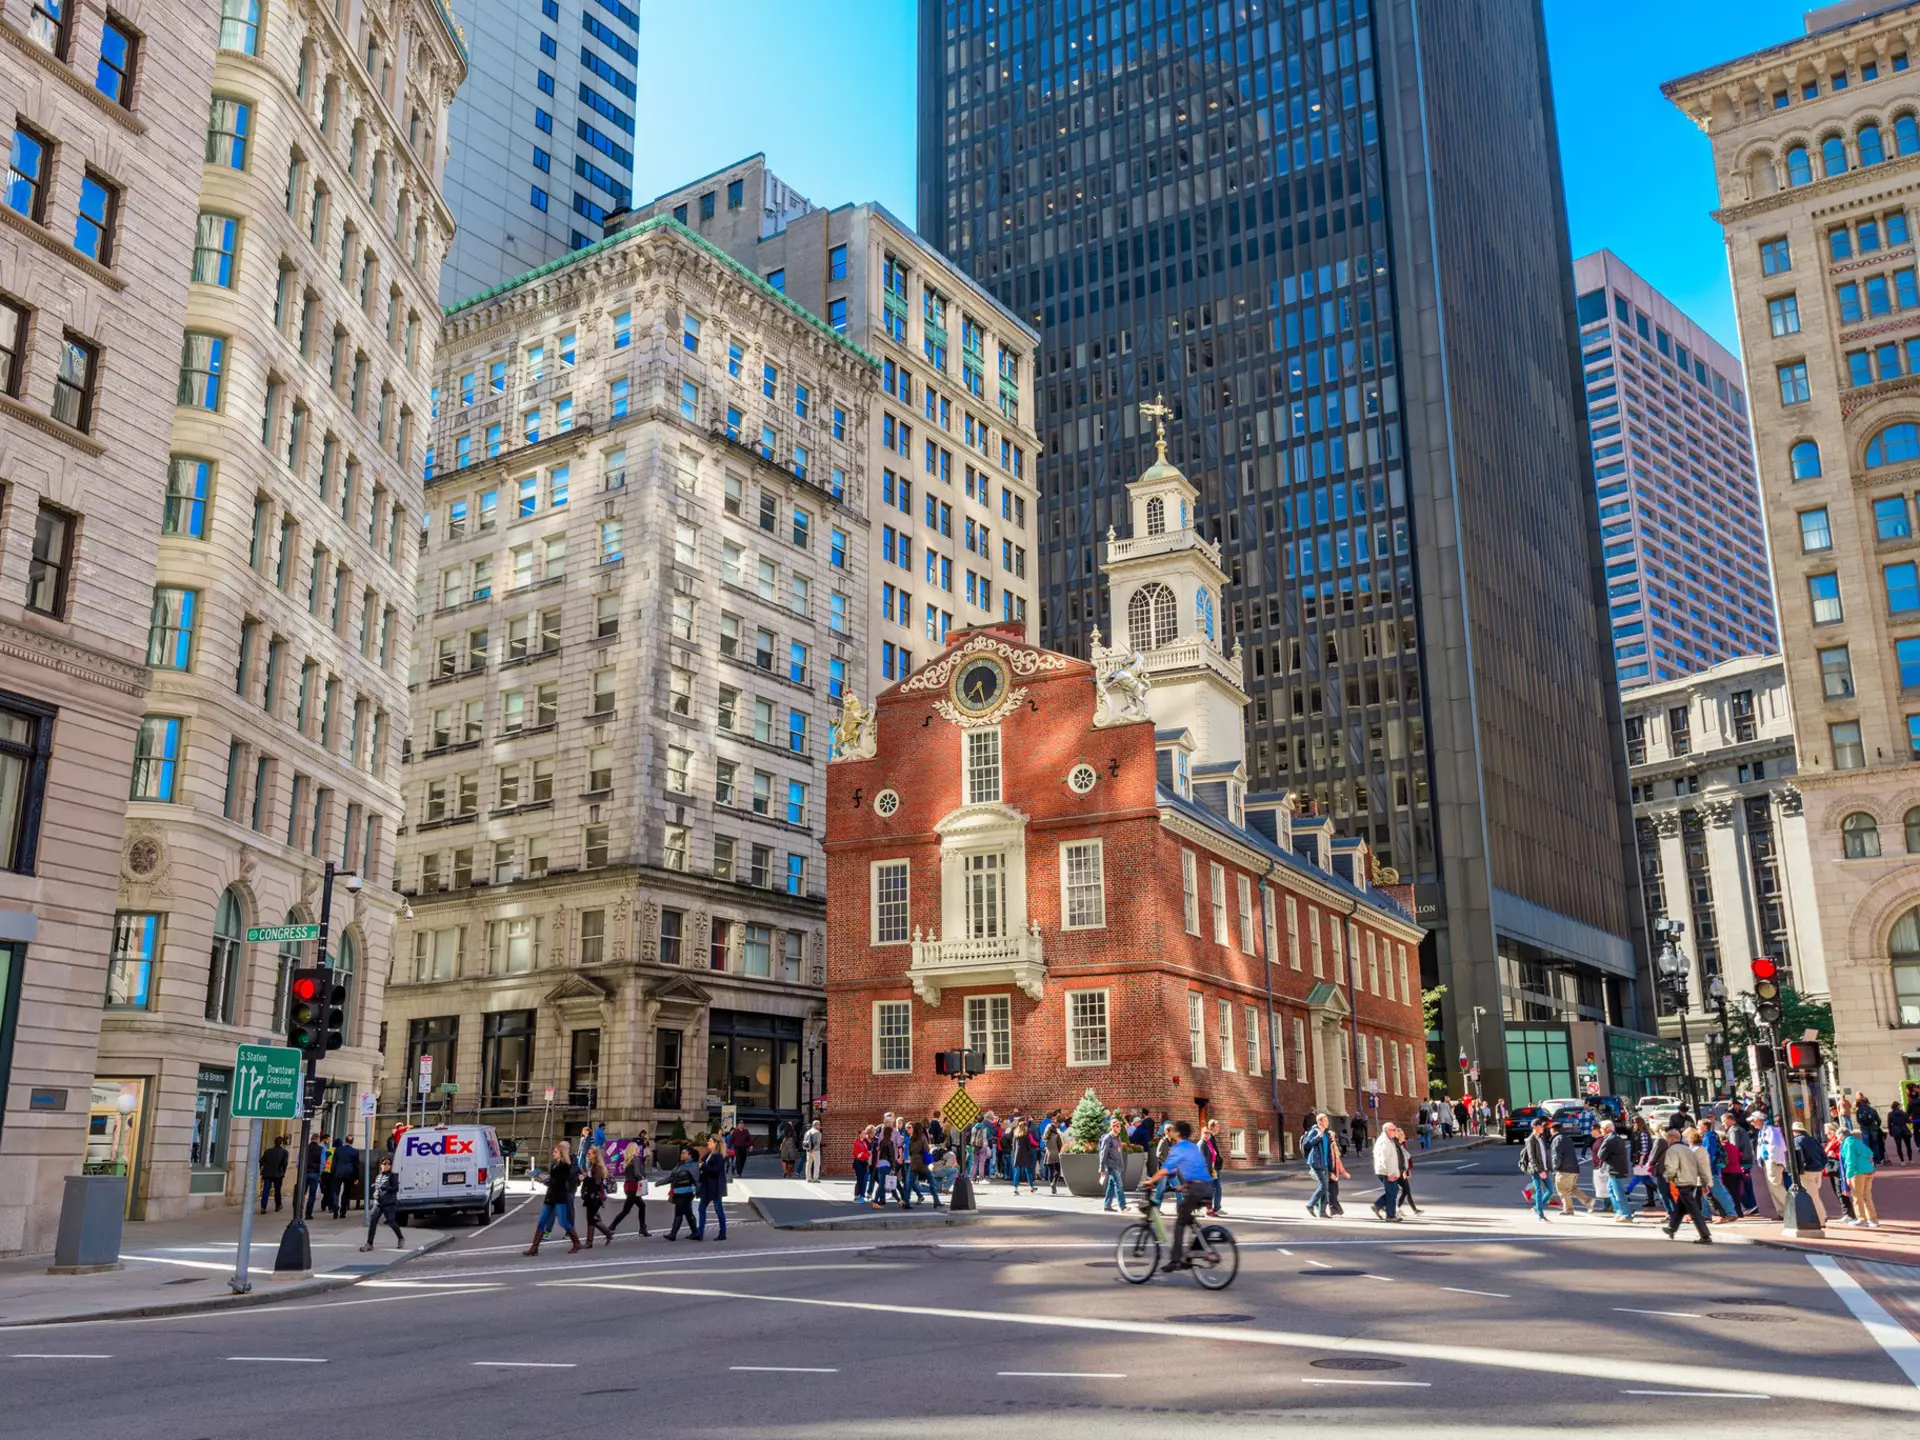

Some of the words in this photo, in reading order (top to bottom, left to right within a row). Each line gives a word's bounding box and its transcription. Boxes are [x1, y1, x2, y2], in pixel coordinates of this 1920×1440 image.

[259, 926, 308, 941] CONGRESS
[247, 1052, 268, 1063] Station
[267, 1064, 295, 1075] Downtown
[267, 1075, 292, 1087] Crossing
[266, 1089, 294, 1099] Government
[265, 1100, 284, 1110] Center
[406, 1135, 474, 1156] FedEx
[444, 1156, 471, 1164] Express
